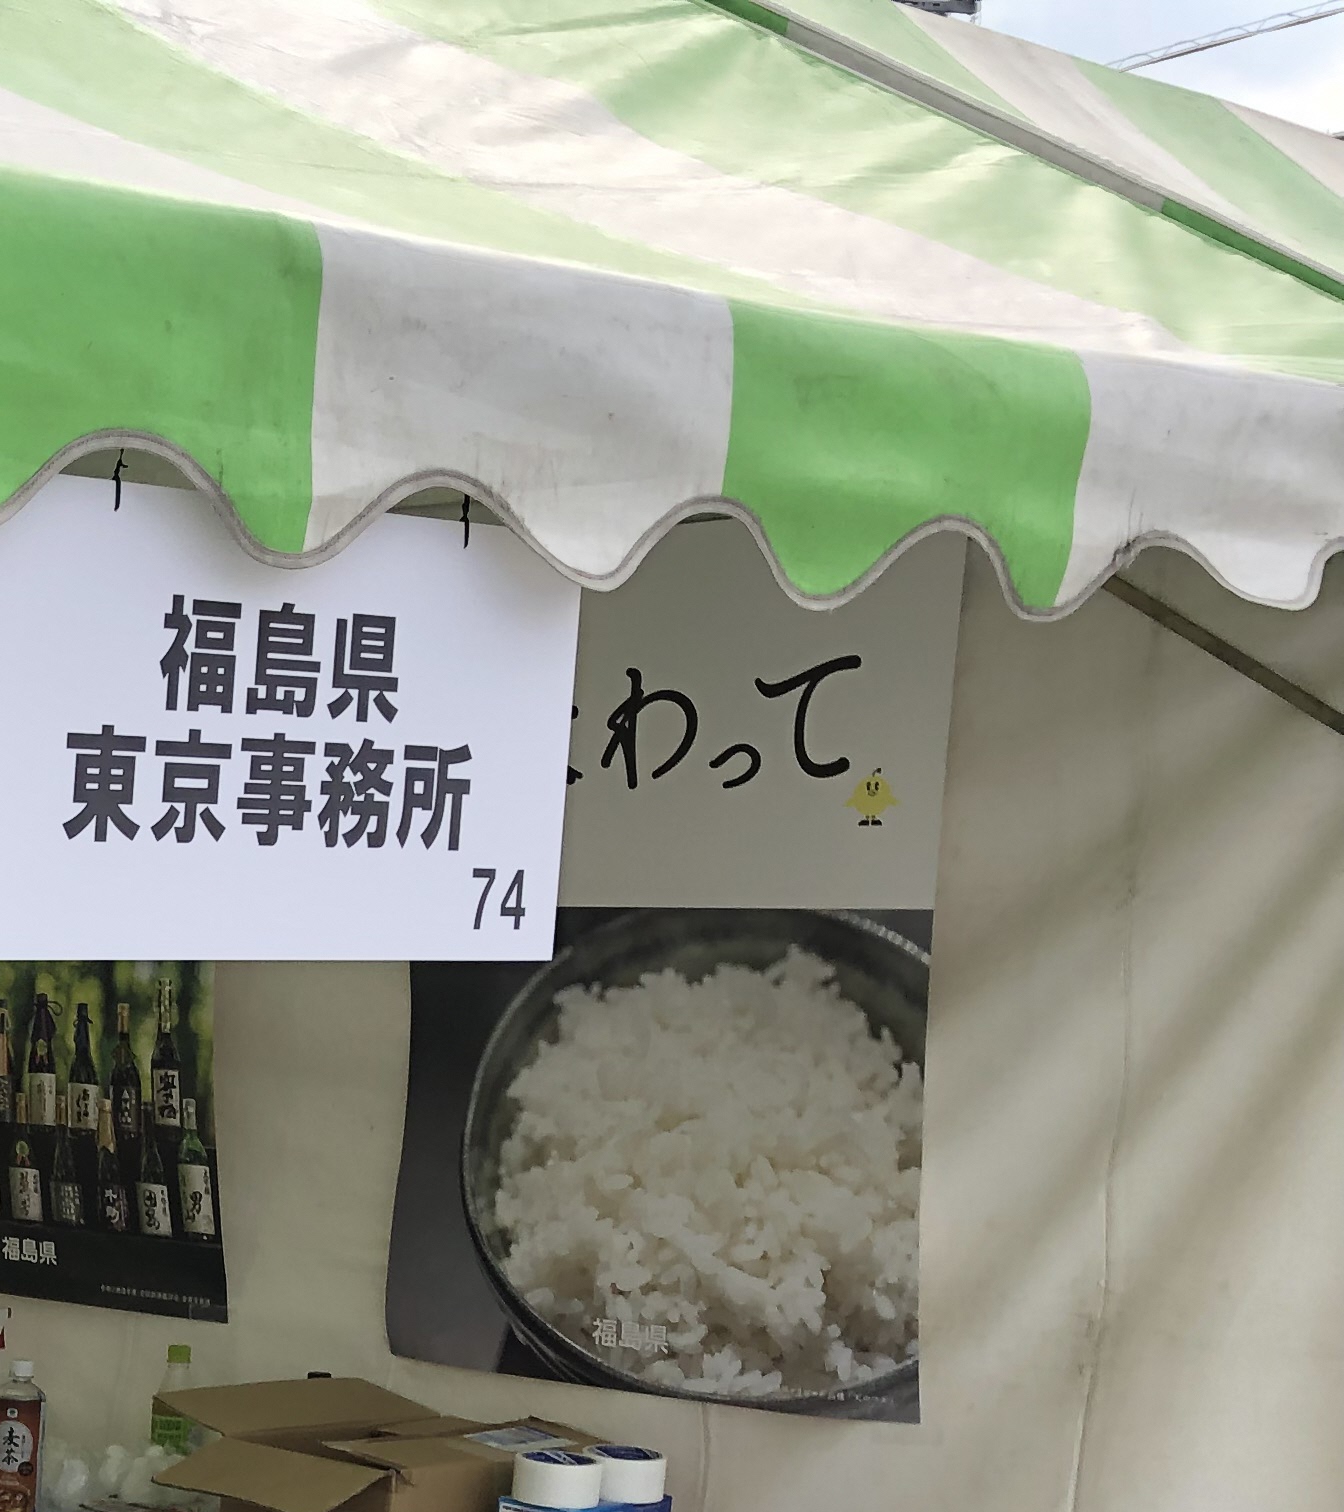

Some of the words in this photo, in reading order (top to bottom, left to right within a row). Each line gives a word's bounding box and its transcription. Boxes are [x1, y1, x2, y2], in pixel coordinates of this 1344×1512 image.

[158, 592, 402, 725] 福島県
[566, 652, 862, 790] わって
[62, 722, 474, 853] 東京事務所
[470, 866, 528, 932] 74
[1, 1236, 58, 1267] 福島県
[591, 1317, 671, 1355] 福島県
